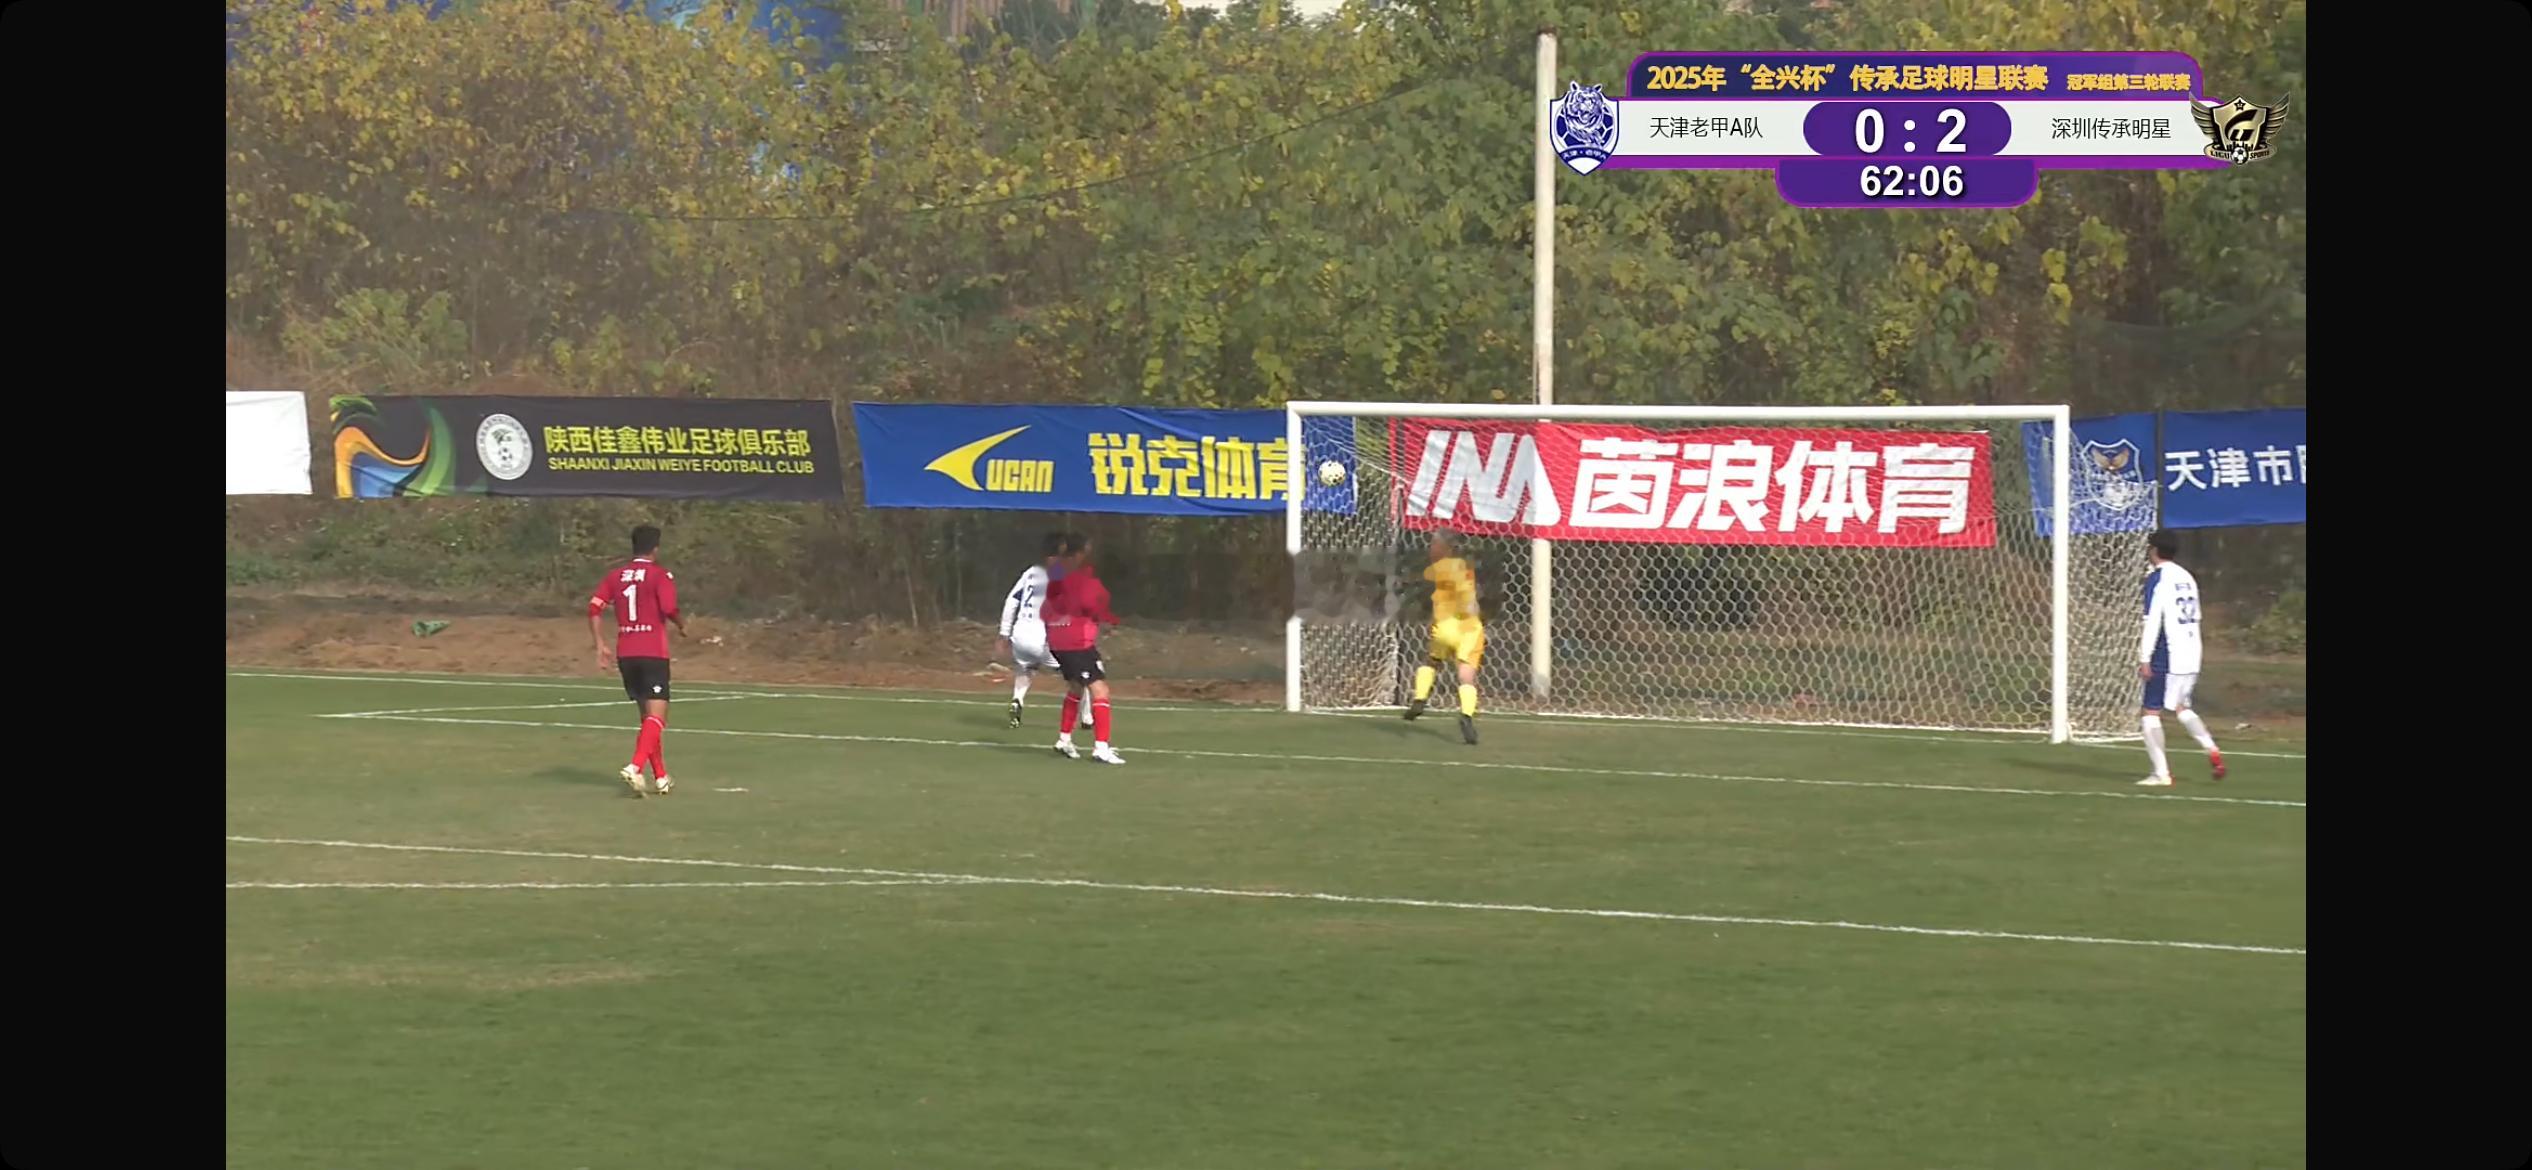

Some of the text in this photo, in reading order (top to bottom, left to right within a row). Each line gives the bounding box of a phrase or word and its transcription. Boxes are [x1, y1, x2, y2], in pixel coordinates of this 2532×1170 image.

[543, 426, 811, 457] 陕西佳鑫伟业足球俱乐部
[548, 457, 815, 474] SHAANXI JIAXIN WEIYE FOOTBALL CLUB
[1089, 432, 1304, 501] 锐克体育
[1569, 436, 1976, 534] 茵浪体育
[2164, 445, 2306, 492] 天津市
[622, 584, 637, 621] 1
